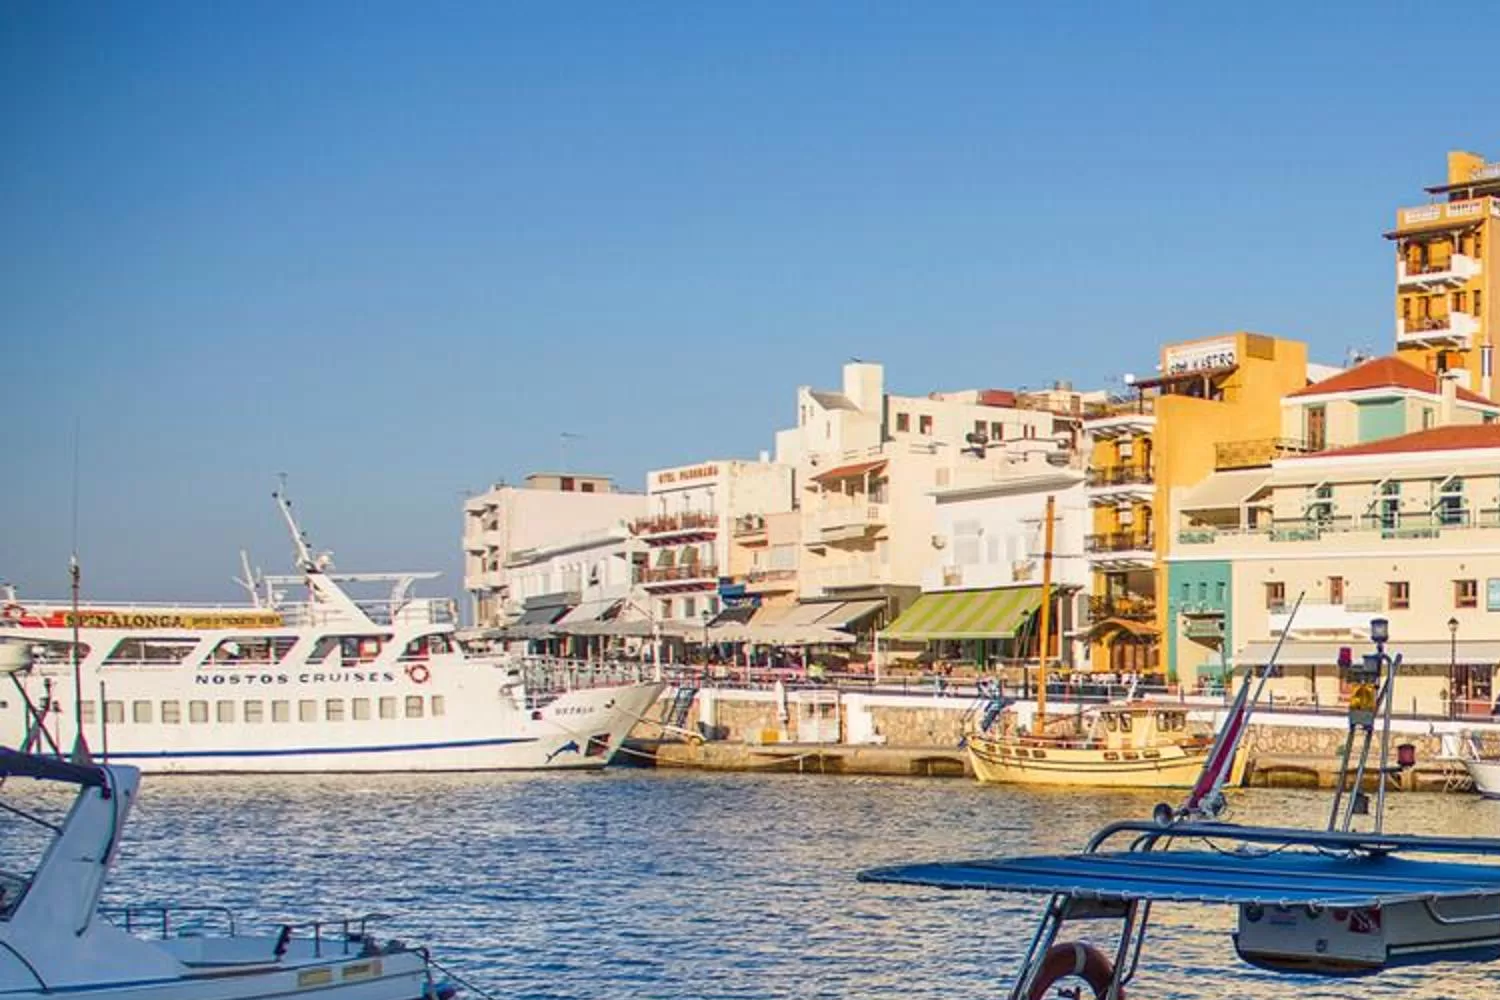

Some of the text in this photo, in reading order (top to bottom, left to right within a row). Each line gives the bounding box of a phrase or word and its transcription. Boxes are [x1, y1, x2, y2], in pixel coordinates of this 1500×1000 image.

[65, 613, 186, 629] SPINALONGA
[195, 671, 395, 685] NOSTOS CRUISES
